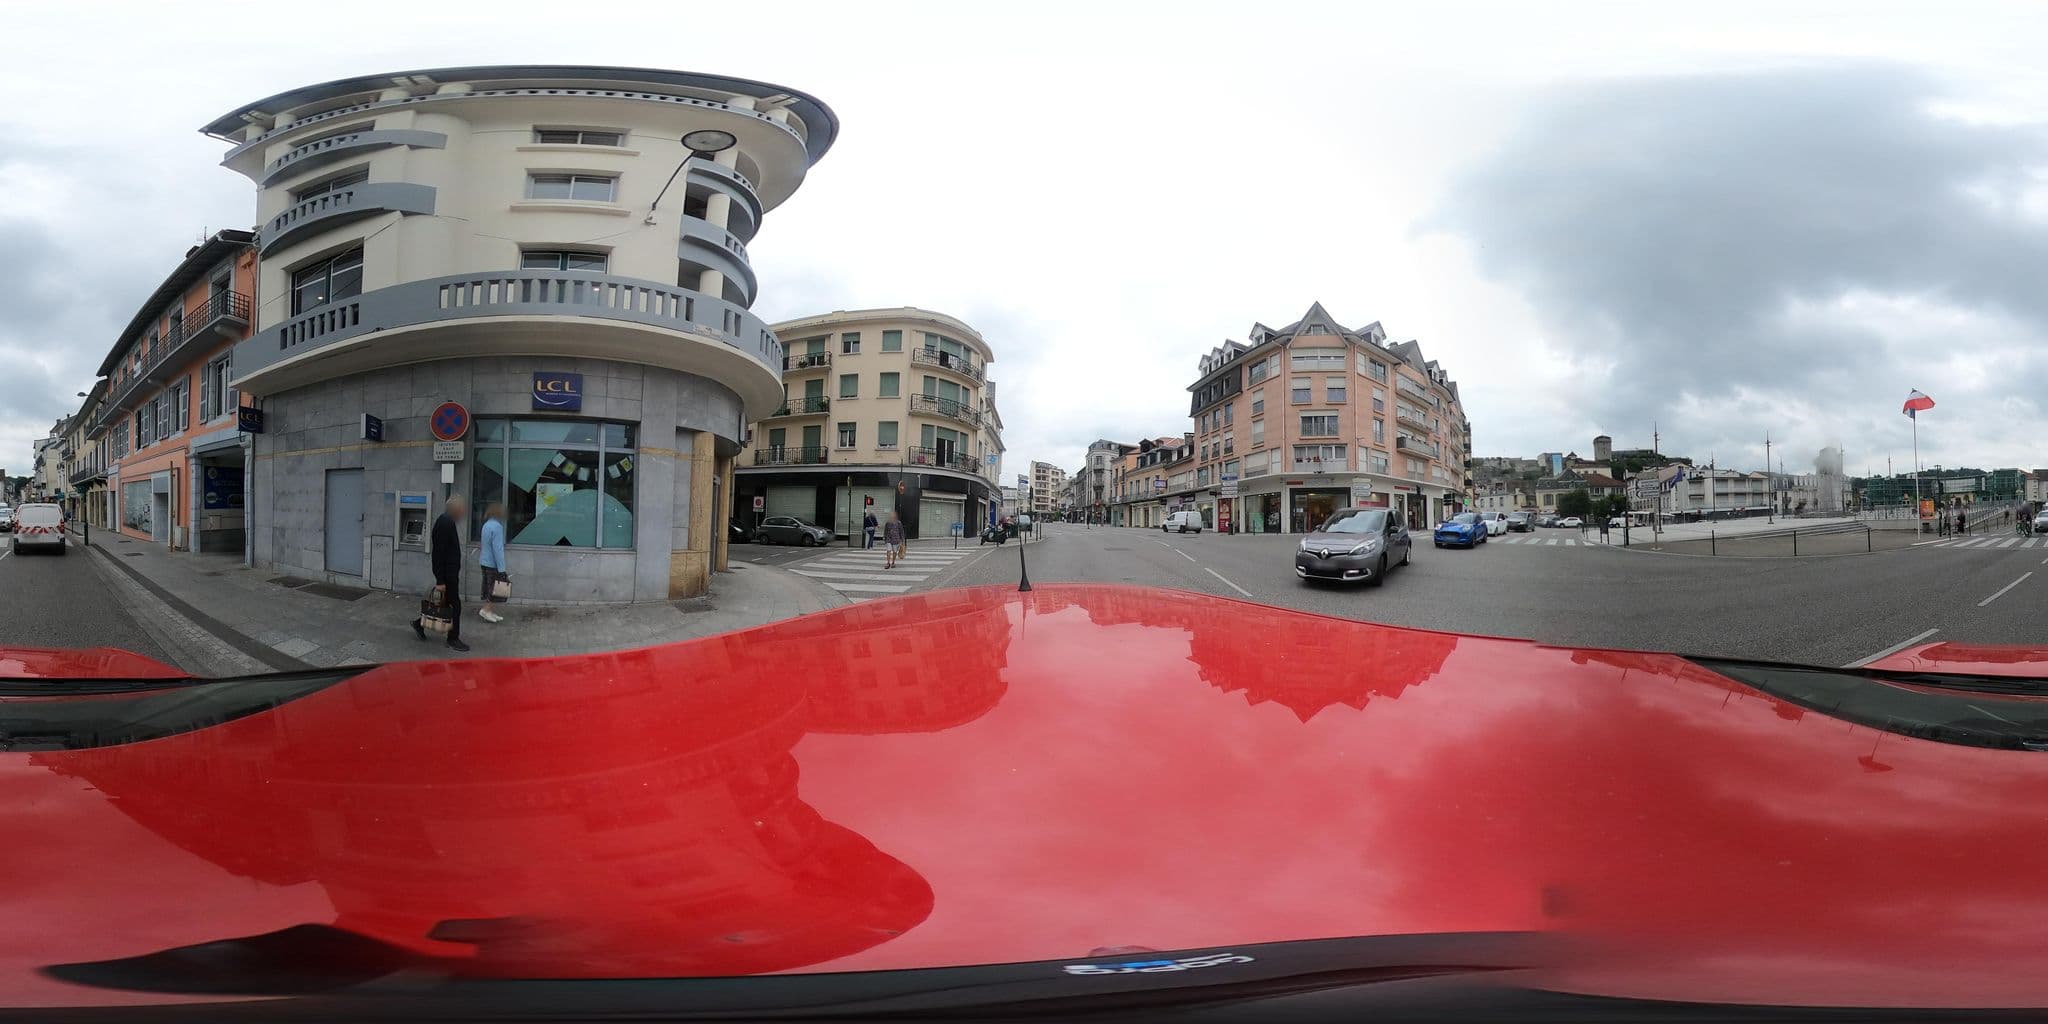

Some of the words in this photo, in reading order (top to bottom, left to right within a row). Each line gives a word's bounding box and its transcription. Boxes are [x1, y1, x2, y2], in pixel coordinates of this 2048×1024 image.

[536, 380, 577, 393] LCL
[240, 412, 262, 424] LCL
[1062, 953, 1256, 975] GoPro
